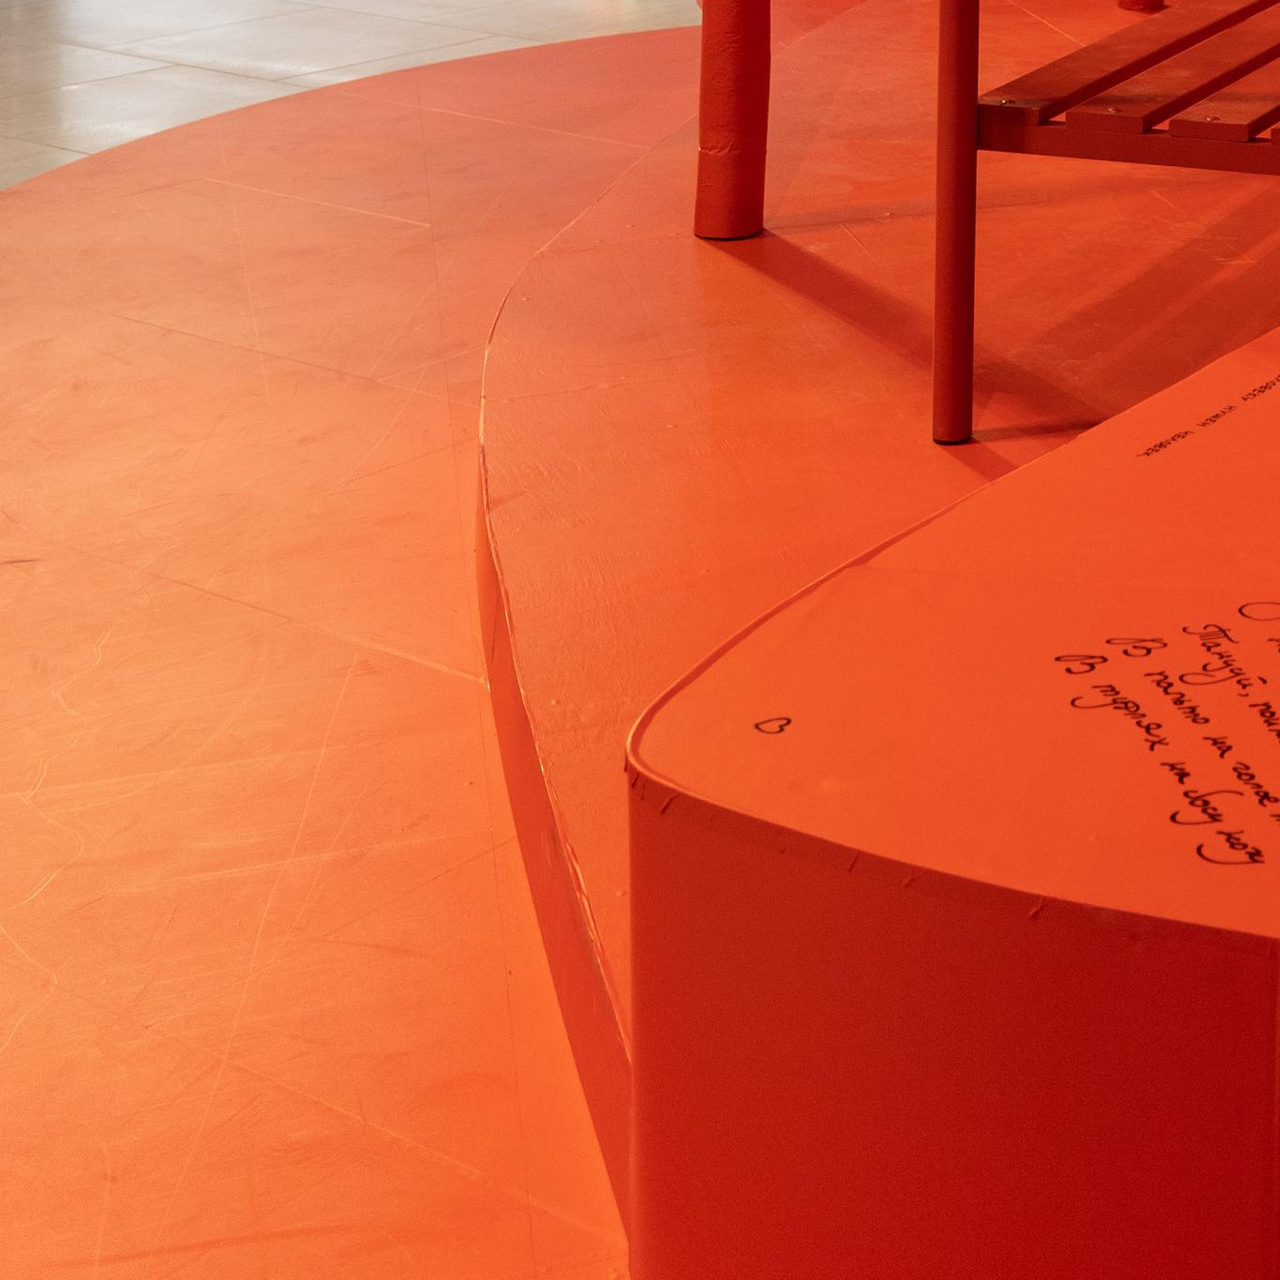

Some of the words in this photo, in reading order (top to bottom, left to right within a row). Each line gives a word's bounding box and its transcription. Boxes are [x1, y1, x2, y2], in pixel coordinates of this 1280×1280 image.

[1069, 683, 1170, 752] туфлях
[1143, 670, 1211, 725] пальто
[1202, 735, 1234, 760] на
[1159, 761, 1192, 785] на
[1168, 789, 1245, 826] босу
